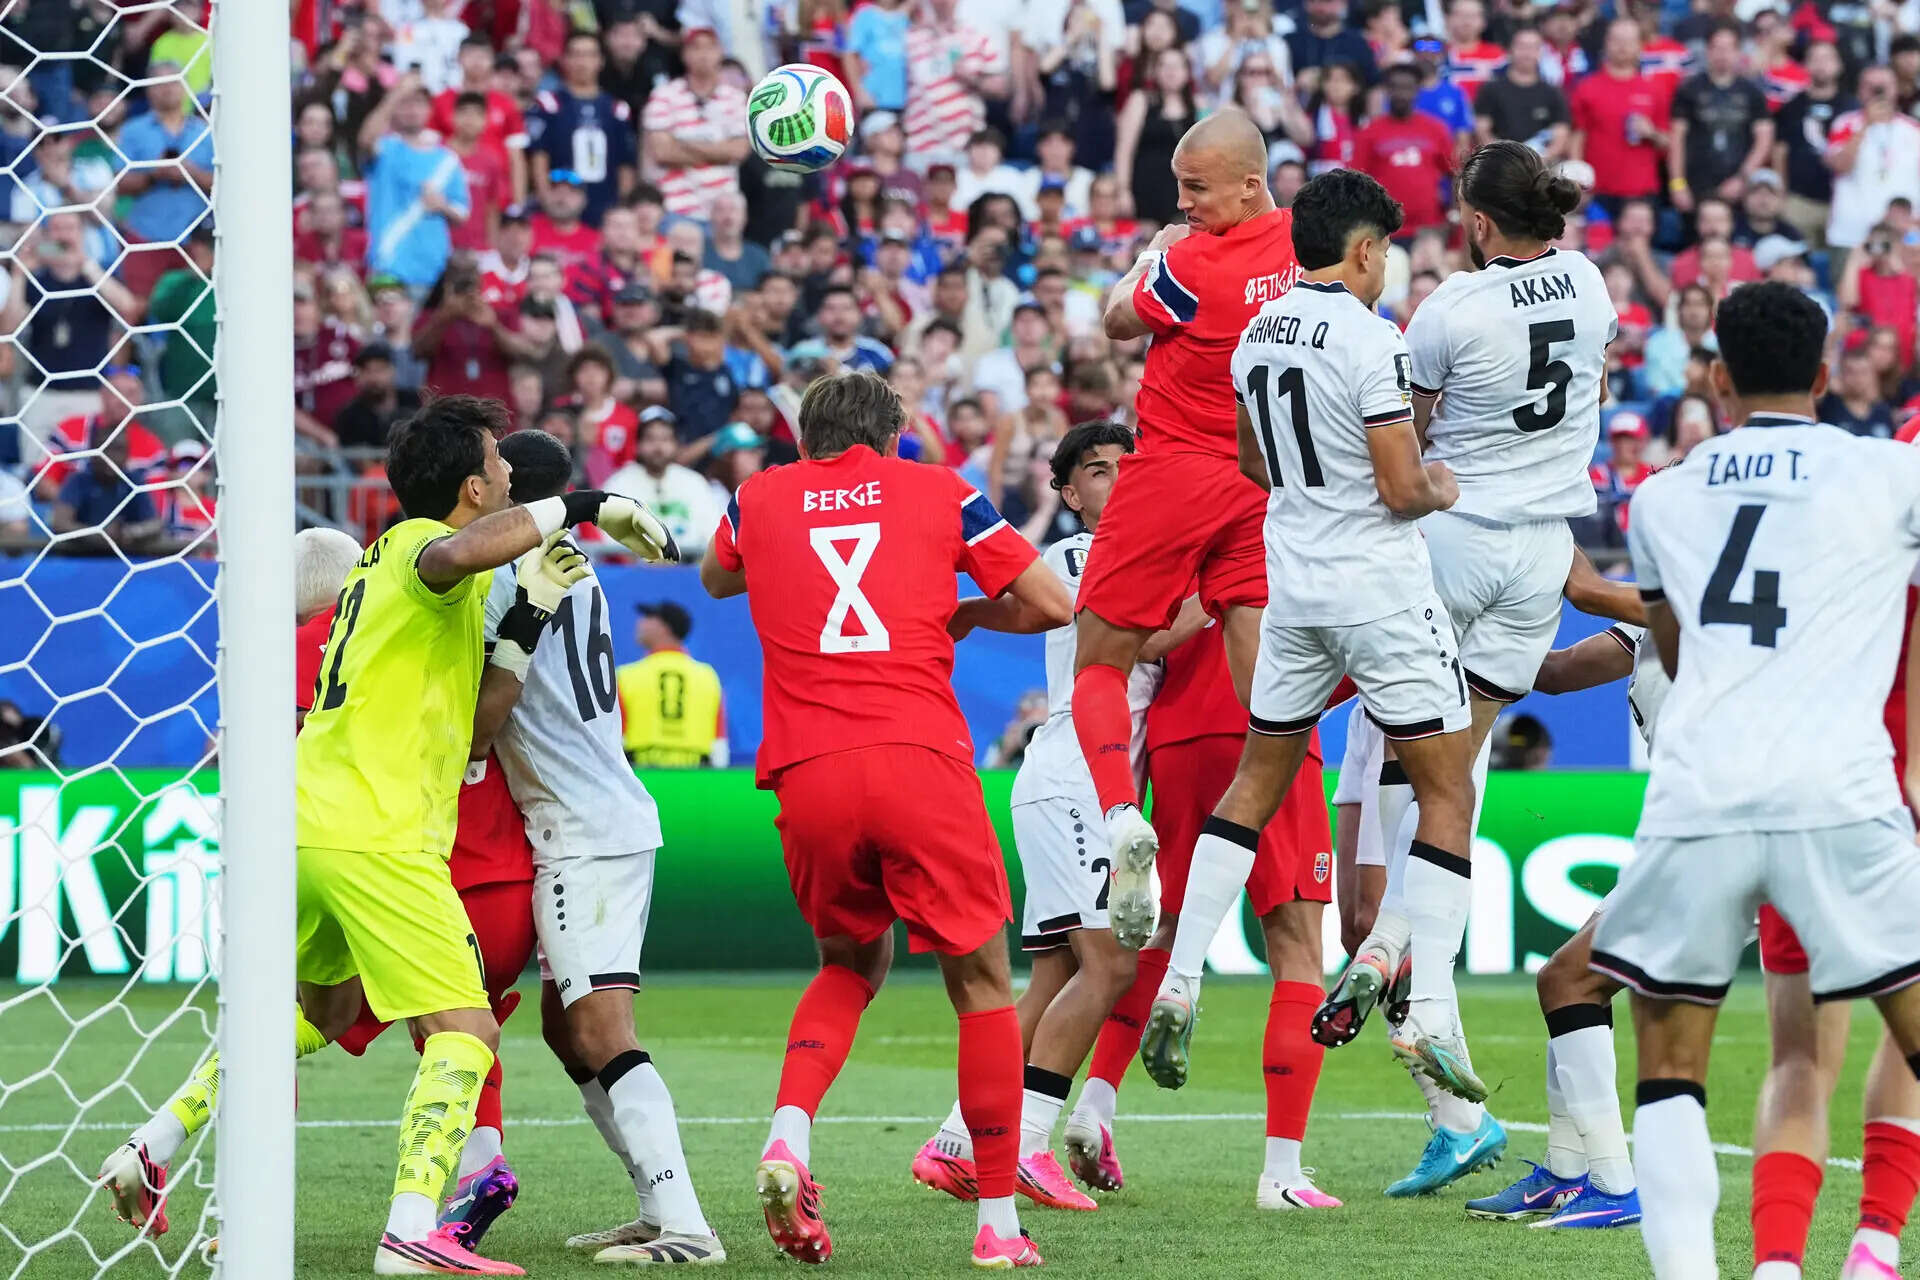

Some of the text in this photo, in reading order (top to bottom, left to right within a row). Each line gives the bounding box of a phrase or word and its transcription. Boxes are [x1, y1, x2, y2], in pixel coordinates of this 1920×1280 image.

[1245, 261, 1305, 305] ØSTIGÅR
[1509, 273, 1577, 308] AKAM
[1246, 364, 1326, 488] 11
[1512, 318, 1576, 433] 5
[803, 480, 883, 513] BERGE
[809, 521, 891, 654] 8
[1699, 504, 1788, 649] 4
[550, 585, 617, 723] 16
